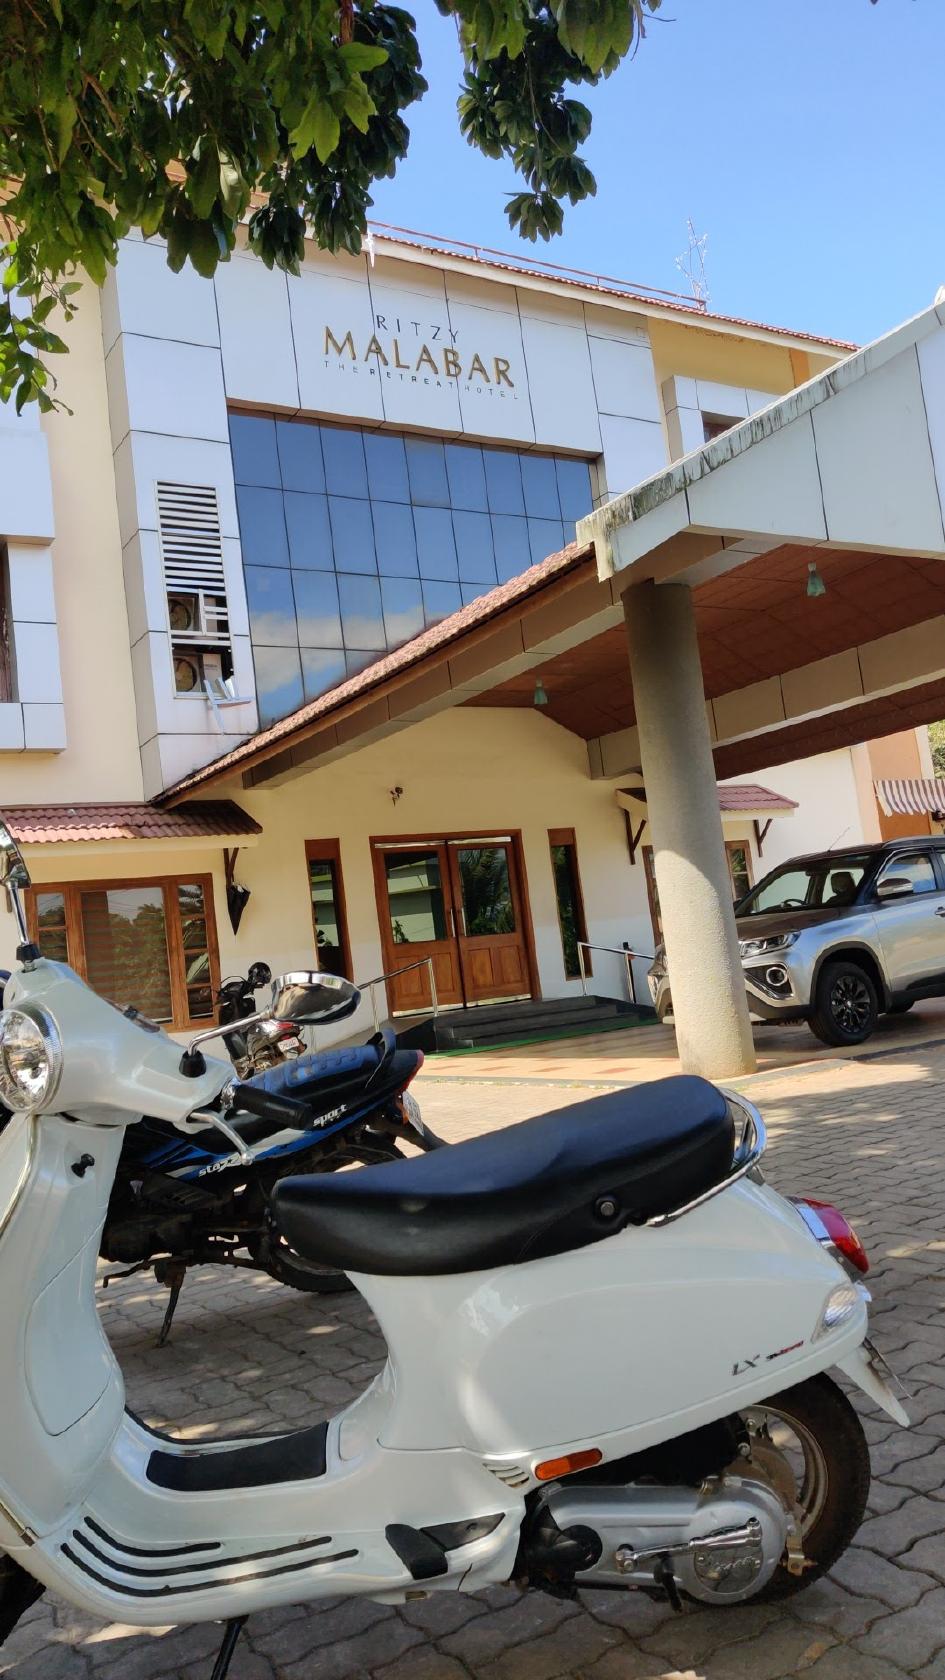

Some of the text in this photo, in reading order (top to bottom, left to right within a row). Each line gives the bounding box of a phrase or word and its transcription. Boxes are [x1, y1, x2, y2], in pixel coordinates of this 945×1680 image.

[376, 314, 459, 343] RITZY
[324, 326, 515, 388] MALABAR
[324, 360, 518, 400] THE RETREAT HOTEL
[313, 1104, 348, 1127] sport
